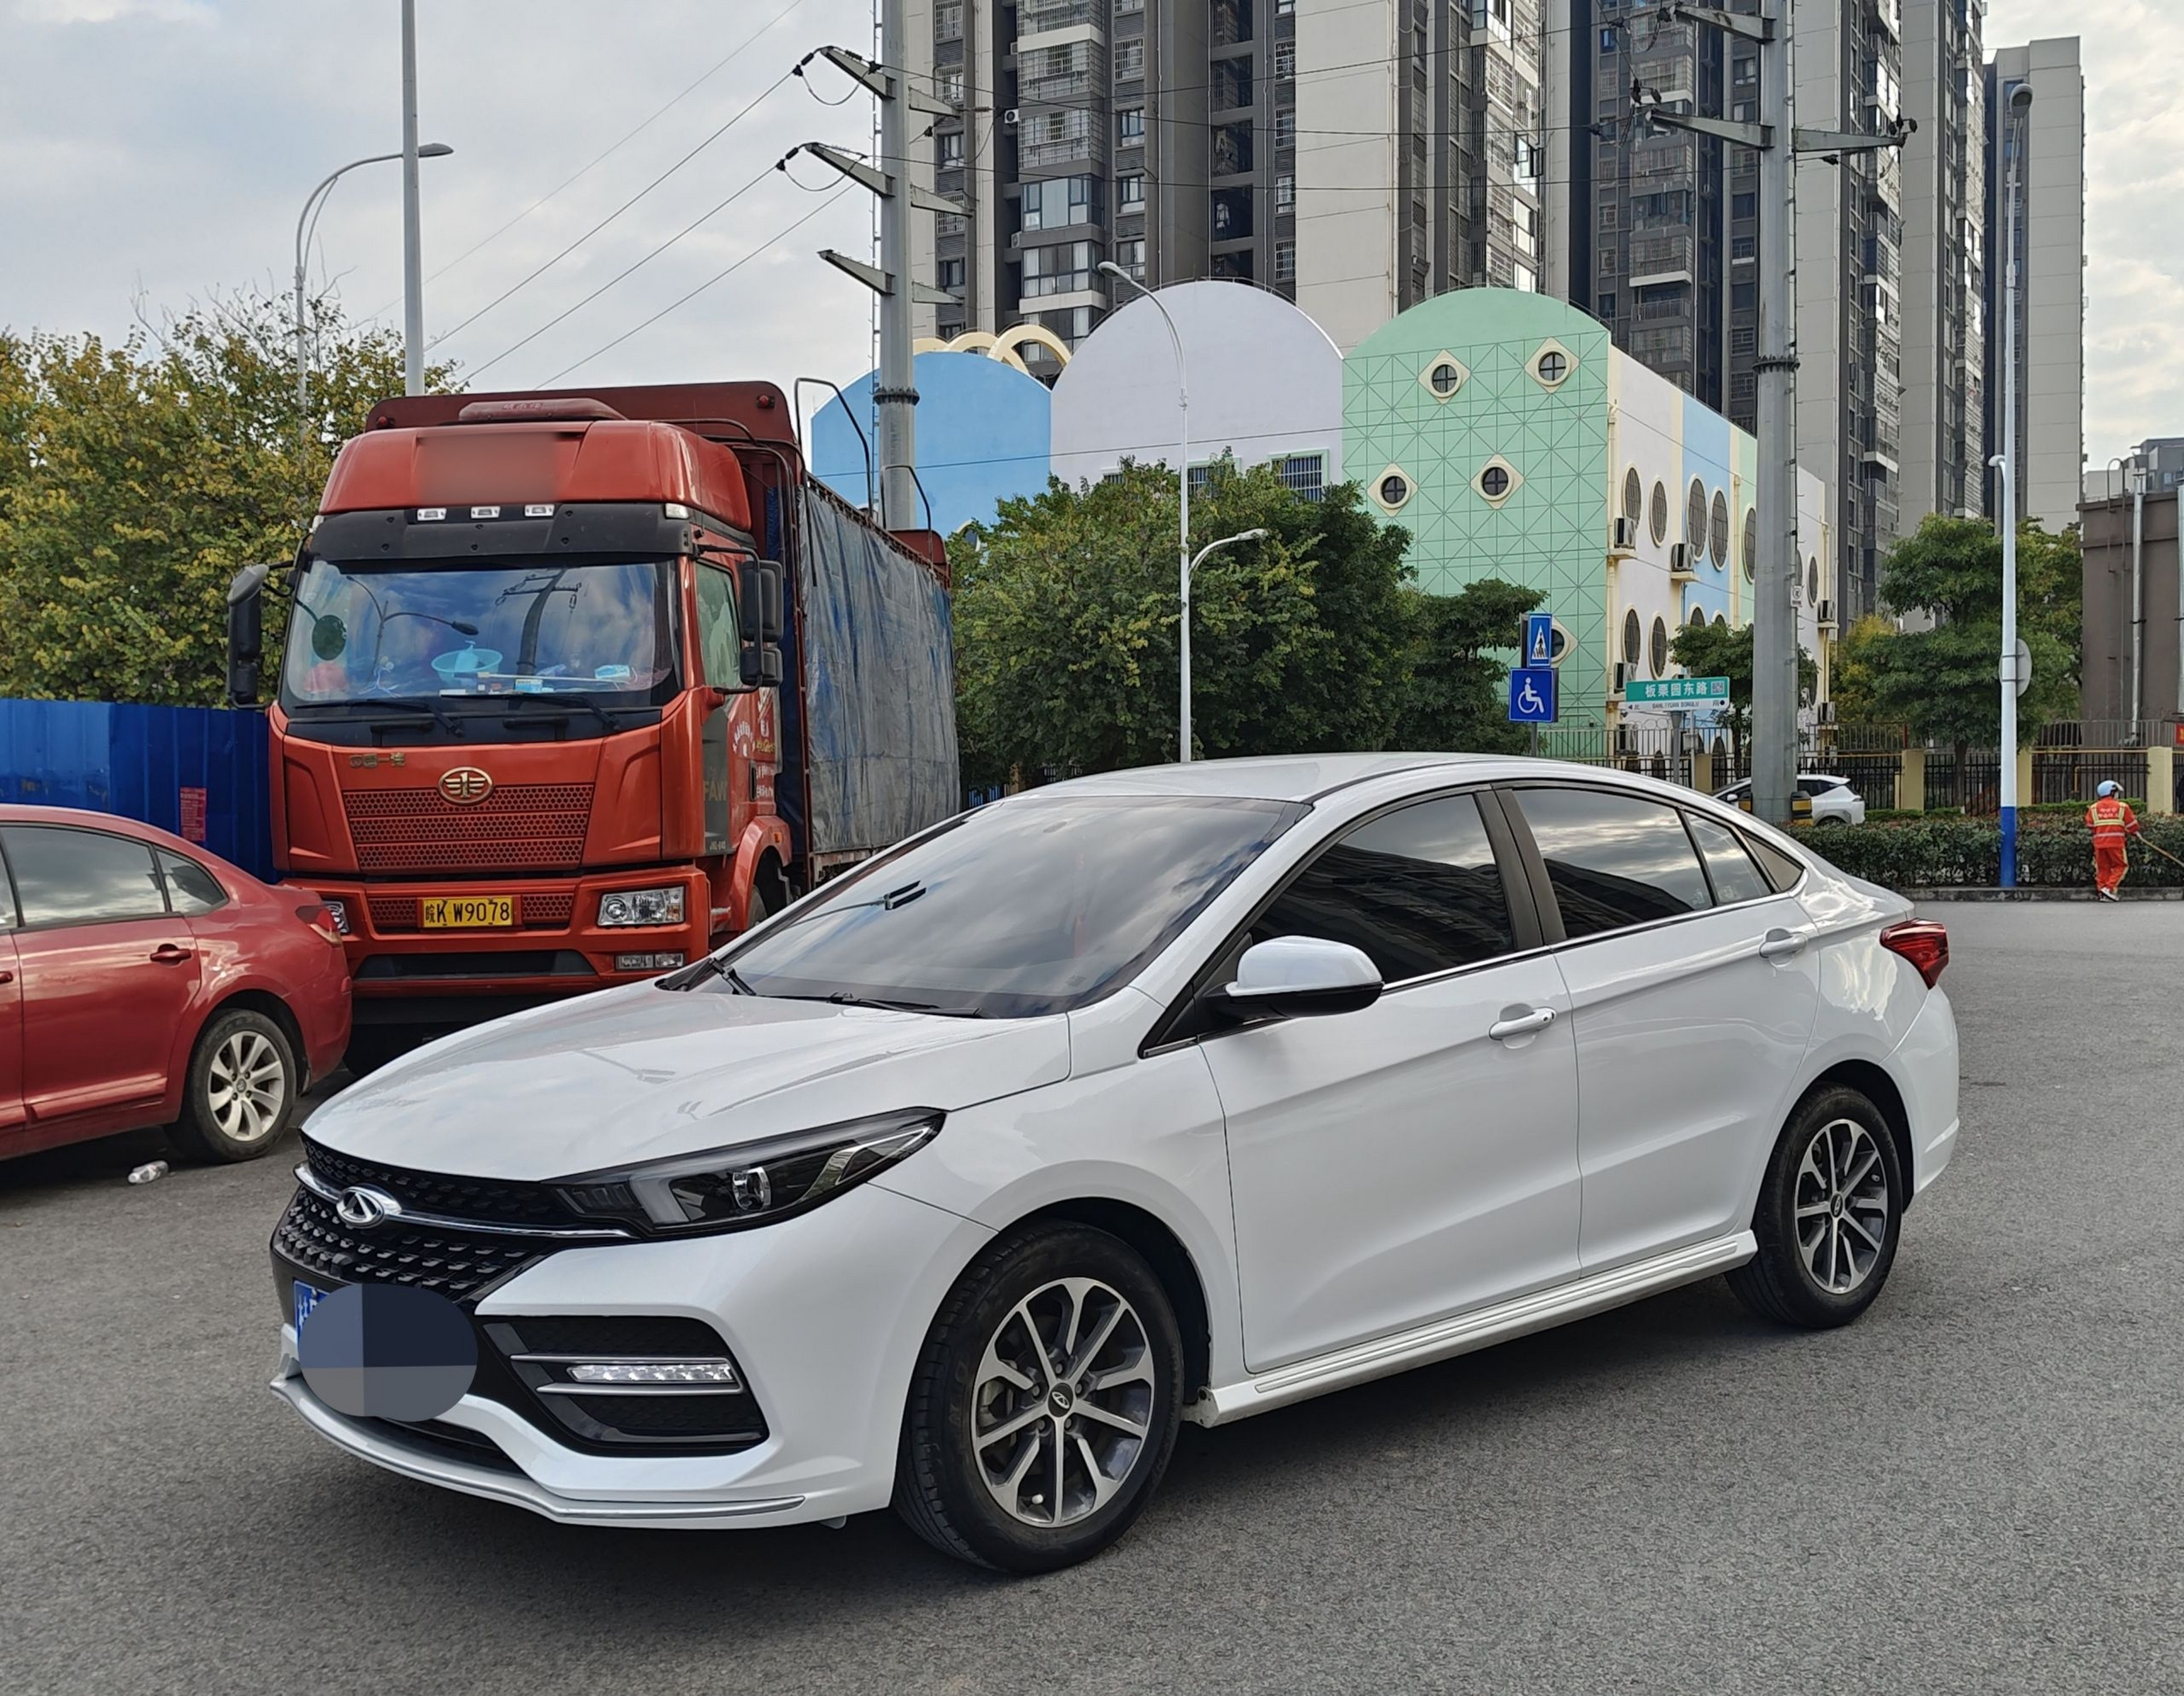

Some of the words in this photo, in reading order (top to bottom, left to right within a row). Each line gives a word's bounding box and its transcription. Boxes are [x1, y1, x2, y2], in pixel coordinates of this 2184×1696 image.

[1645, 682, 1707, 698] 板栗园东路
[704, 780, 727, 801] FAW
[425, 901, 510, 923] 皖KW9078
